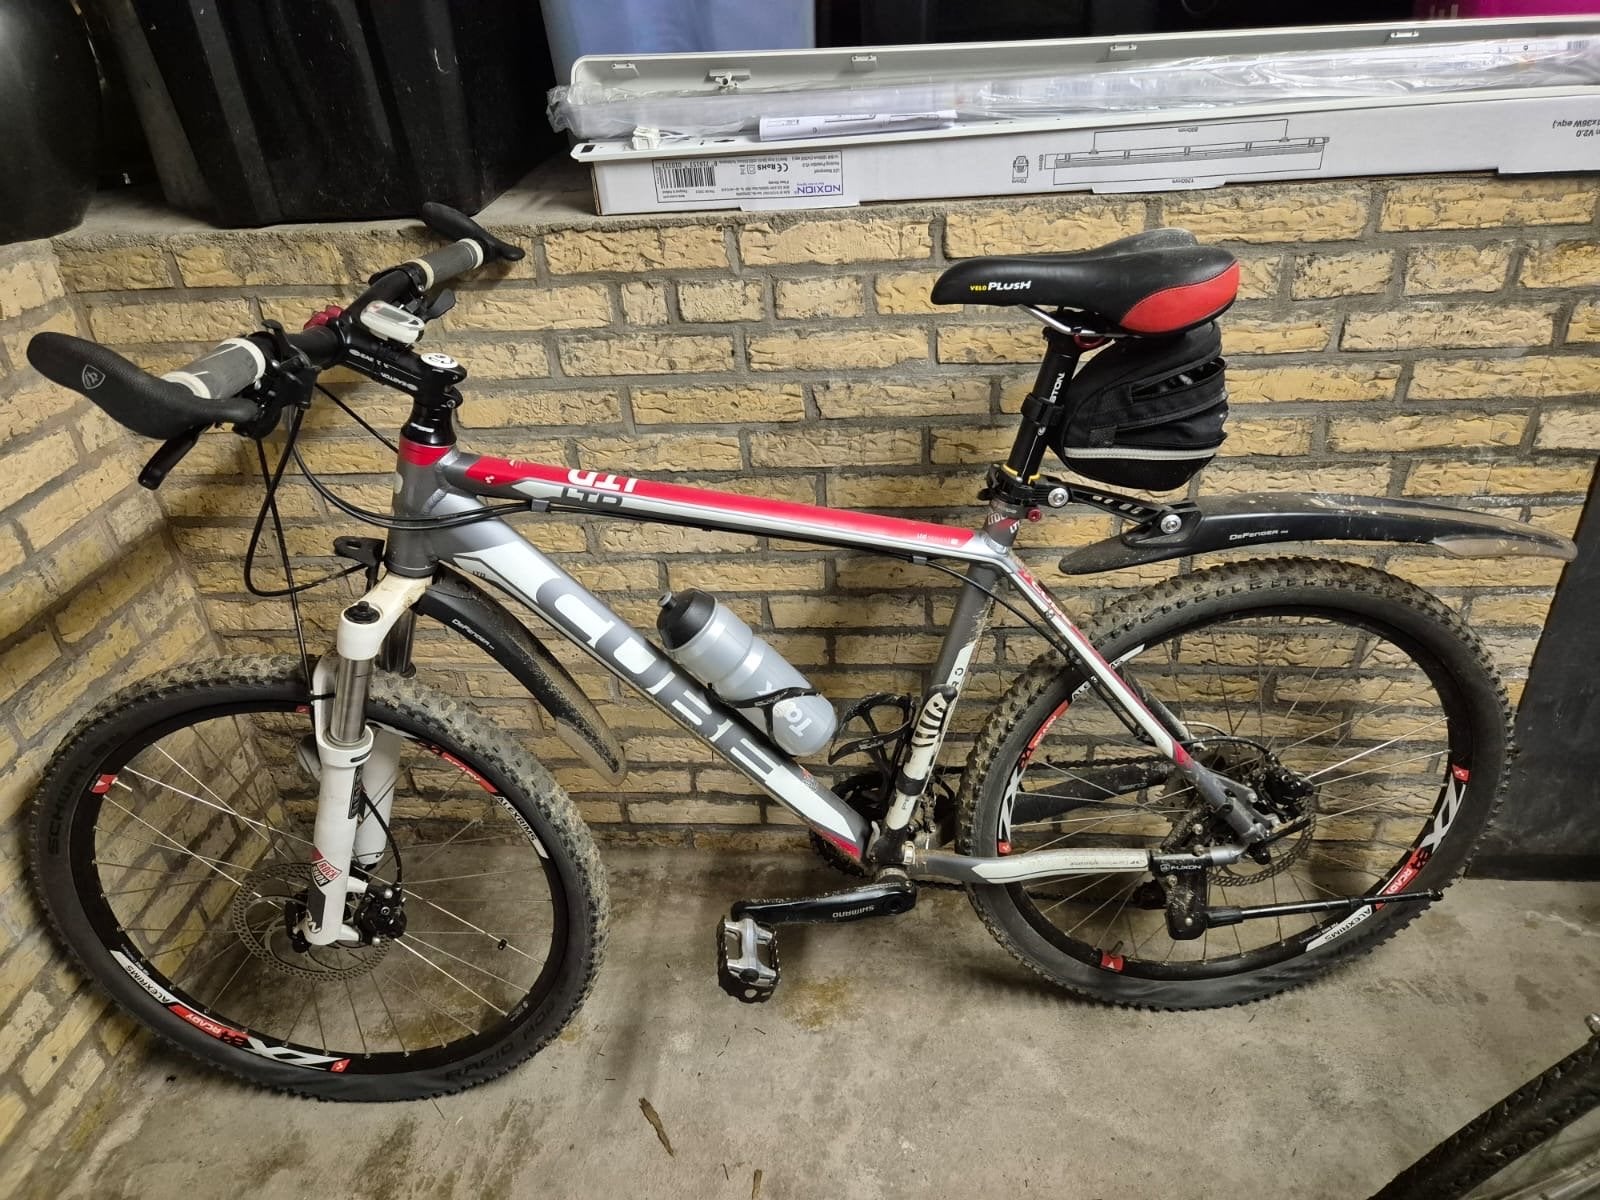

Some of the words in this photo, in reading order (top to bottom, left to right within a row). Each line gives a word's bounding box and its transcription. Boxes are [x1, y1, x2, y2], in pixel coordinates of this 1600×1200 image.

[797, 184, 841, 194] NOXION
[987, 280, 1032, 291] PLUSH
[535, 577, 778, 786] CUBE
[757, 679, 812, 738] Tax
[318, 862, 338, 880] ROCK
[832, 904, 875, 918] SHIMANO
[126, 965, 170, 1003] ALEXRIMS
